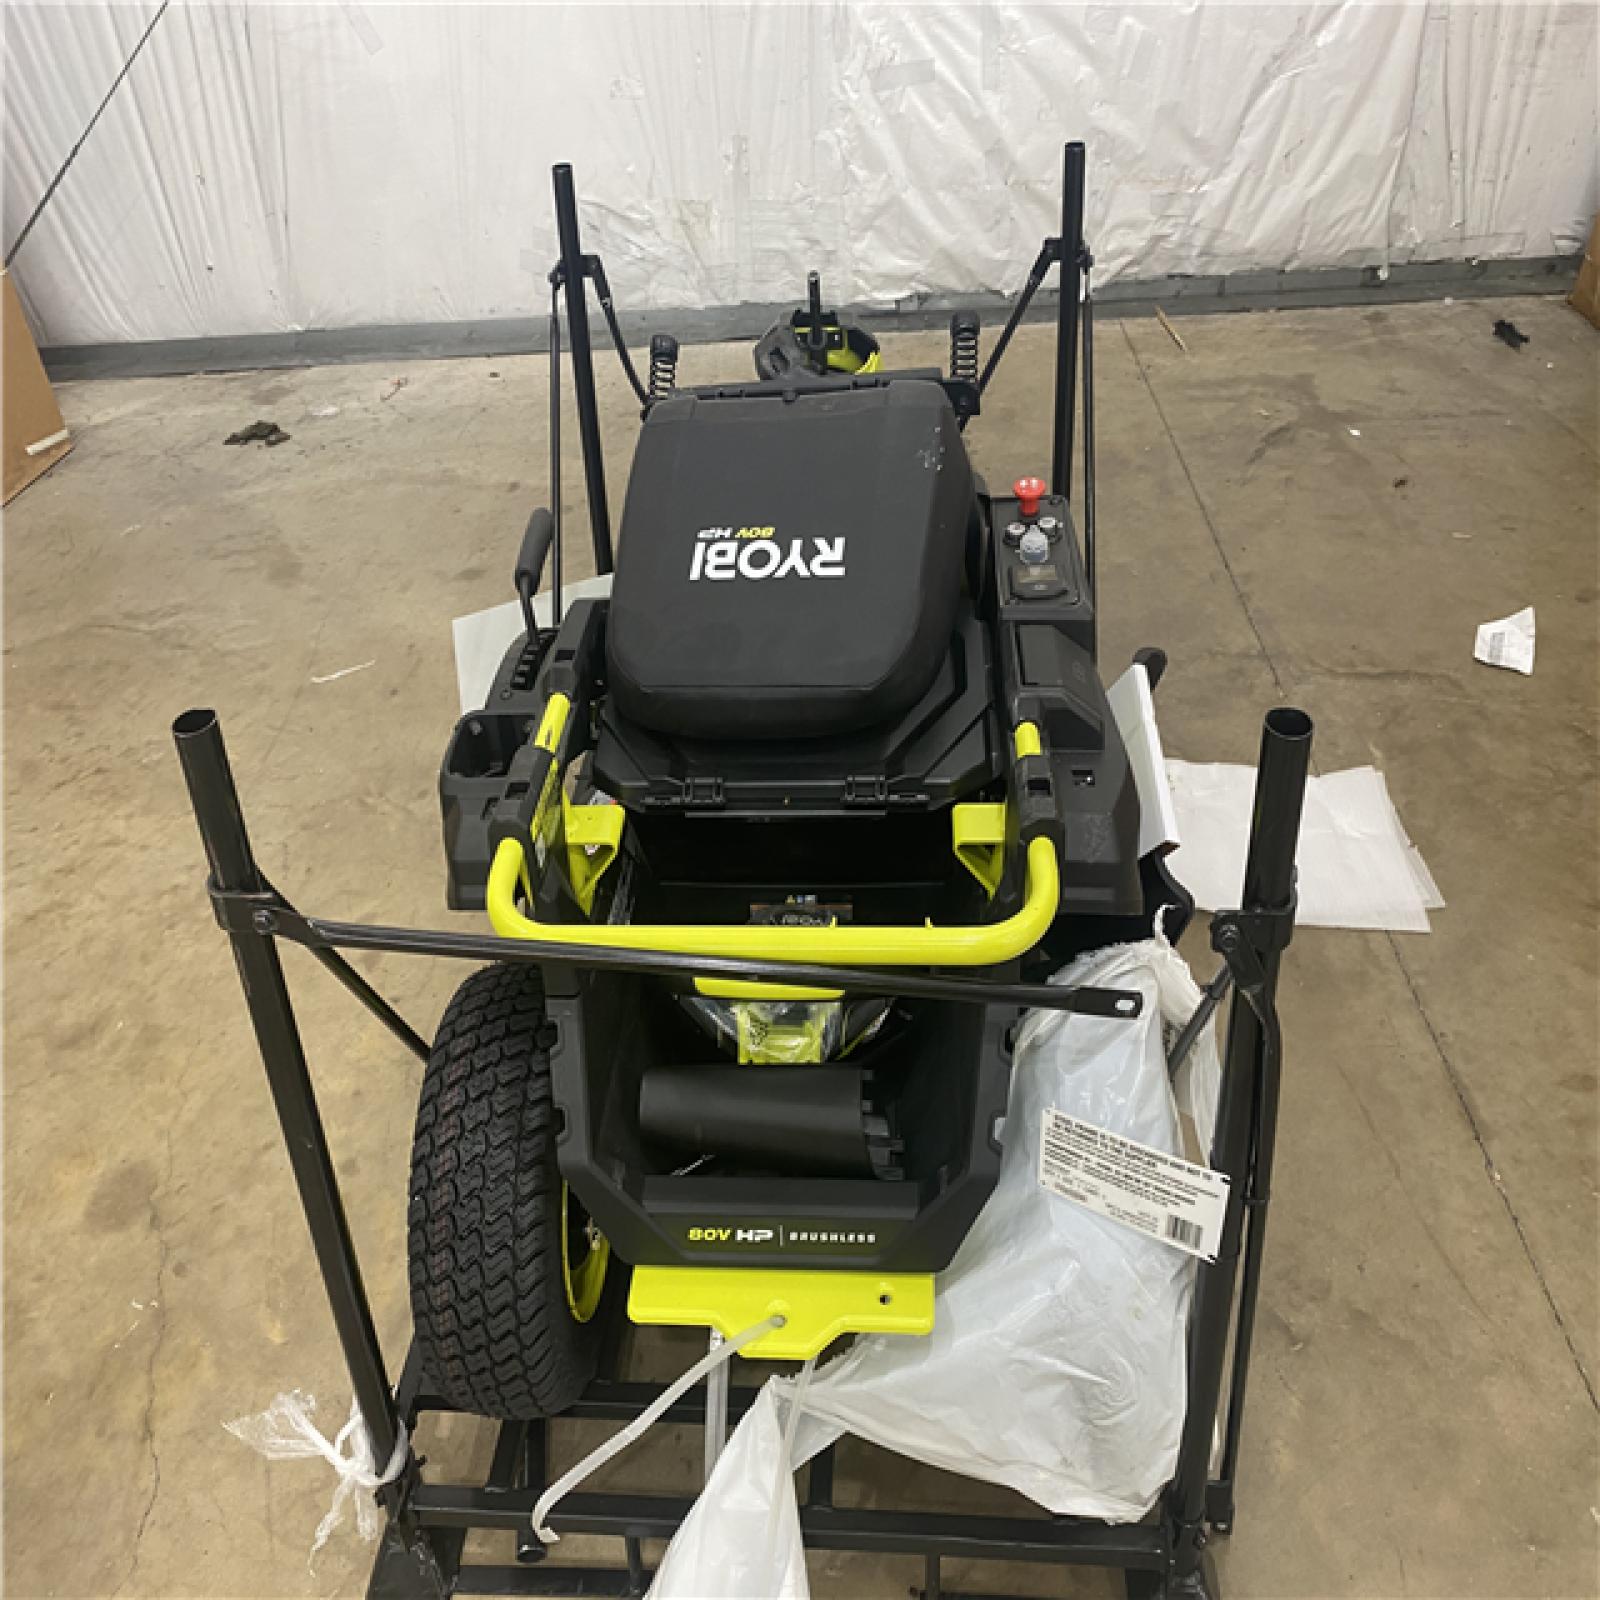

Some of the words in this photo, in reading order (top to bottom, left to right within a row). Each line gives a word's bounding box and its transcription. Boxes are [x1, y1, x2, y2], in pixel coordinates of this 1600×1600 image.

[697, 527, 733, 538] HP
[735, 527, 776, 538] 80V
[690, 537, 845, 581] RYOBI
[688, 1227, 731, 1241] 80V
[735, 1229, 773, 1242] HP
